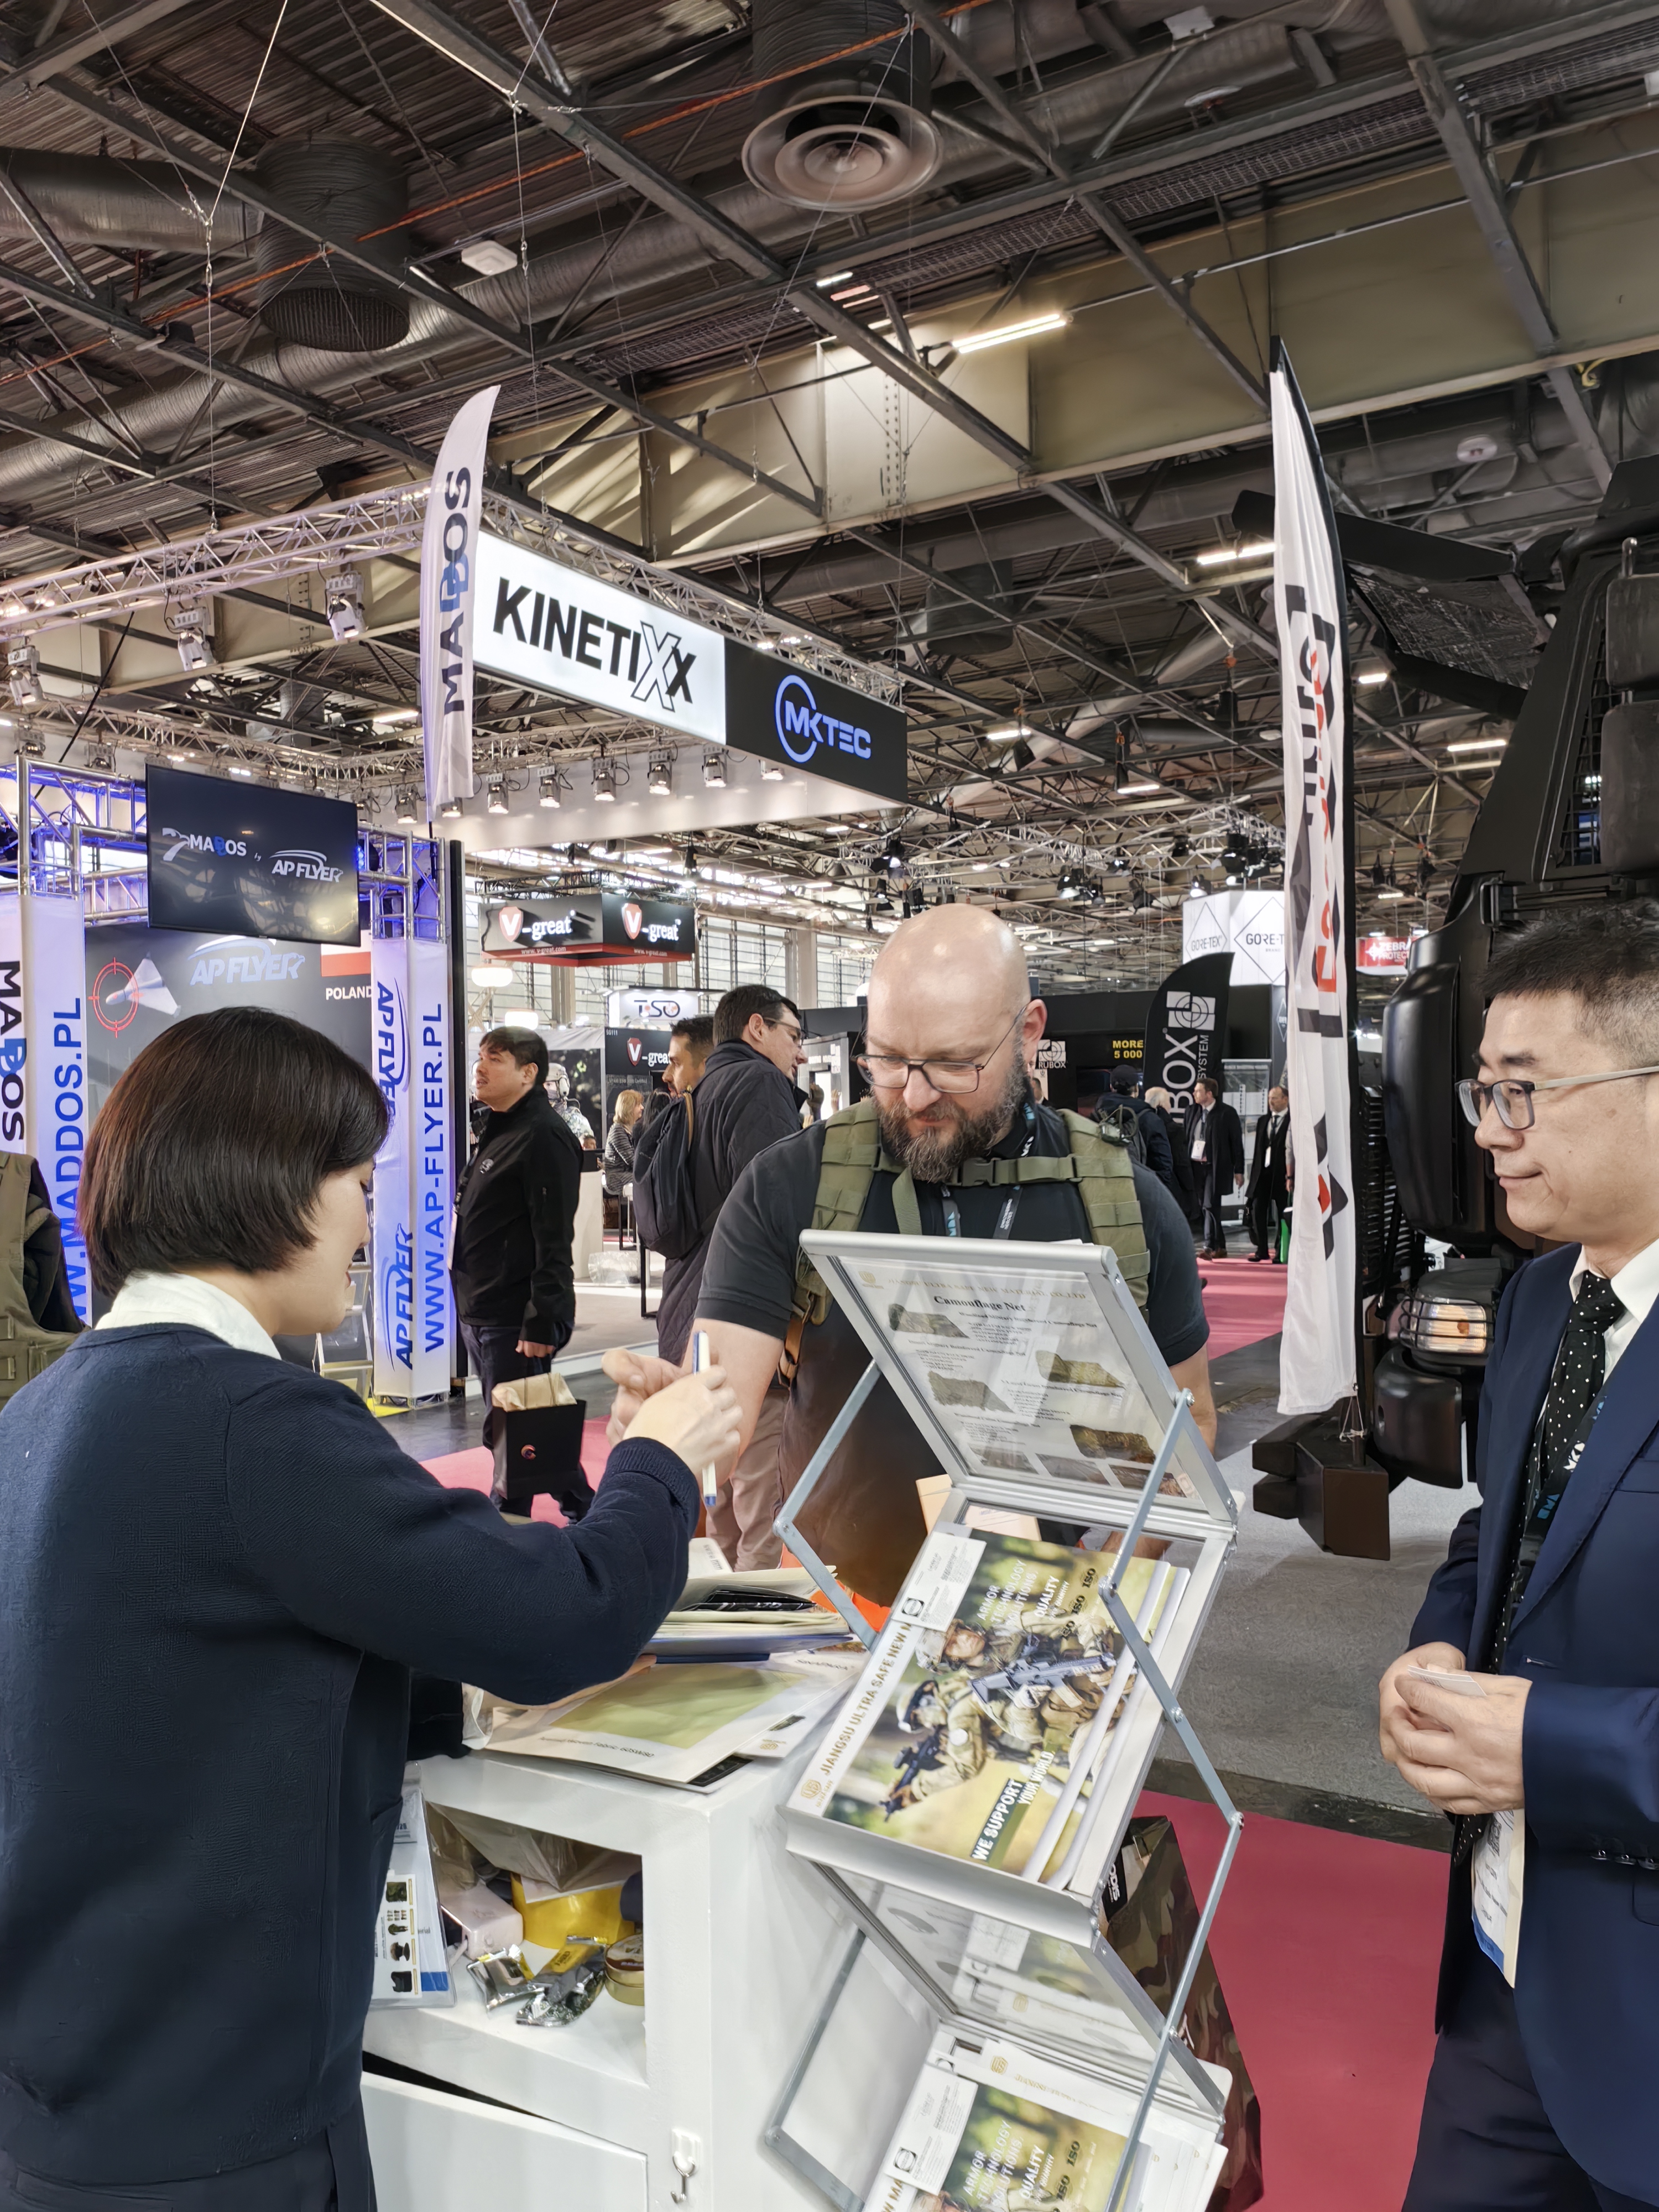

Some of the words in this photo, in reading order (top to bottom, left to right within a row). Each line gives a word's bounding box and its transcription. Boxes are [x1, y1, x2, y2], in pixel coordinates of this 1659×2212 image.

[1245, 933, 1285, 945] GORE-T
[325, 986, 372, 1000] POLAND
[628, 1042, 670, 1067] V-grea
[1112, 1040, 1144, 1049] MORE
[1114, 1050, 1120, 1059] 5
[1123, 1050, 1143, 1059] 000
[1038, 1061, 1067, 1070] RUBOX
[1163, 1034, 1198, 1123] BOX
[422, 1003, 445, 1354] WWW.AP-FLYER.PL
[933, 1295, 1003, 1312] Camouflage
[1004, 1301, 1026, 1312] Net
[1082, 1567, 1097, 1588] ISO
[1034, 1575, 1060, 1618] QUALITY
[1070, 1594, 1086, 1615] ISO
[819, 1726, 856, 1777] JIANGSU
[849, 1689, 879, 1726] ULTRA
[870, 1658, 896, 1688] SAFE
[1016, 1781, 1041, 1806] YOUR
[972, 1837, 994, 1861] WE
[983, 1778, 1023, 1839] SUPPORT
[1066, 2140, 1081, 2167] ISO
[1019, 2144, 1045, 2200] QUALITY
